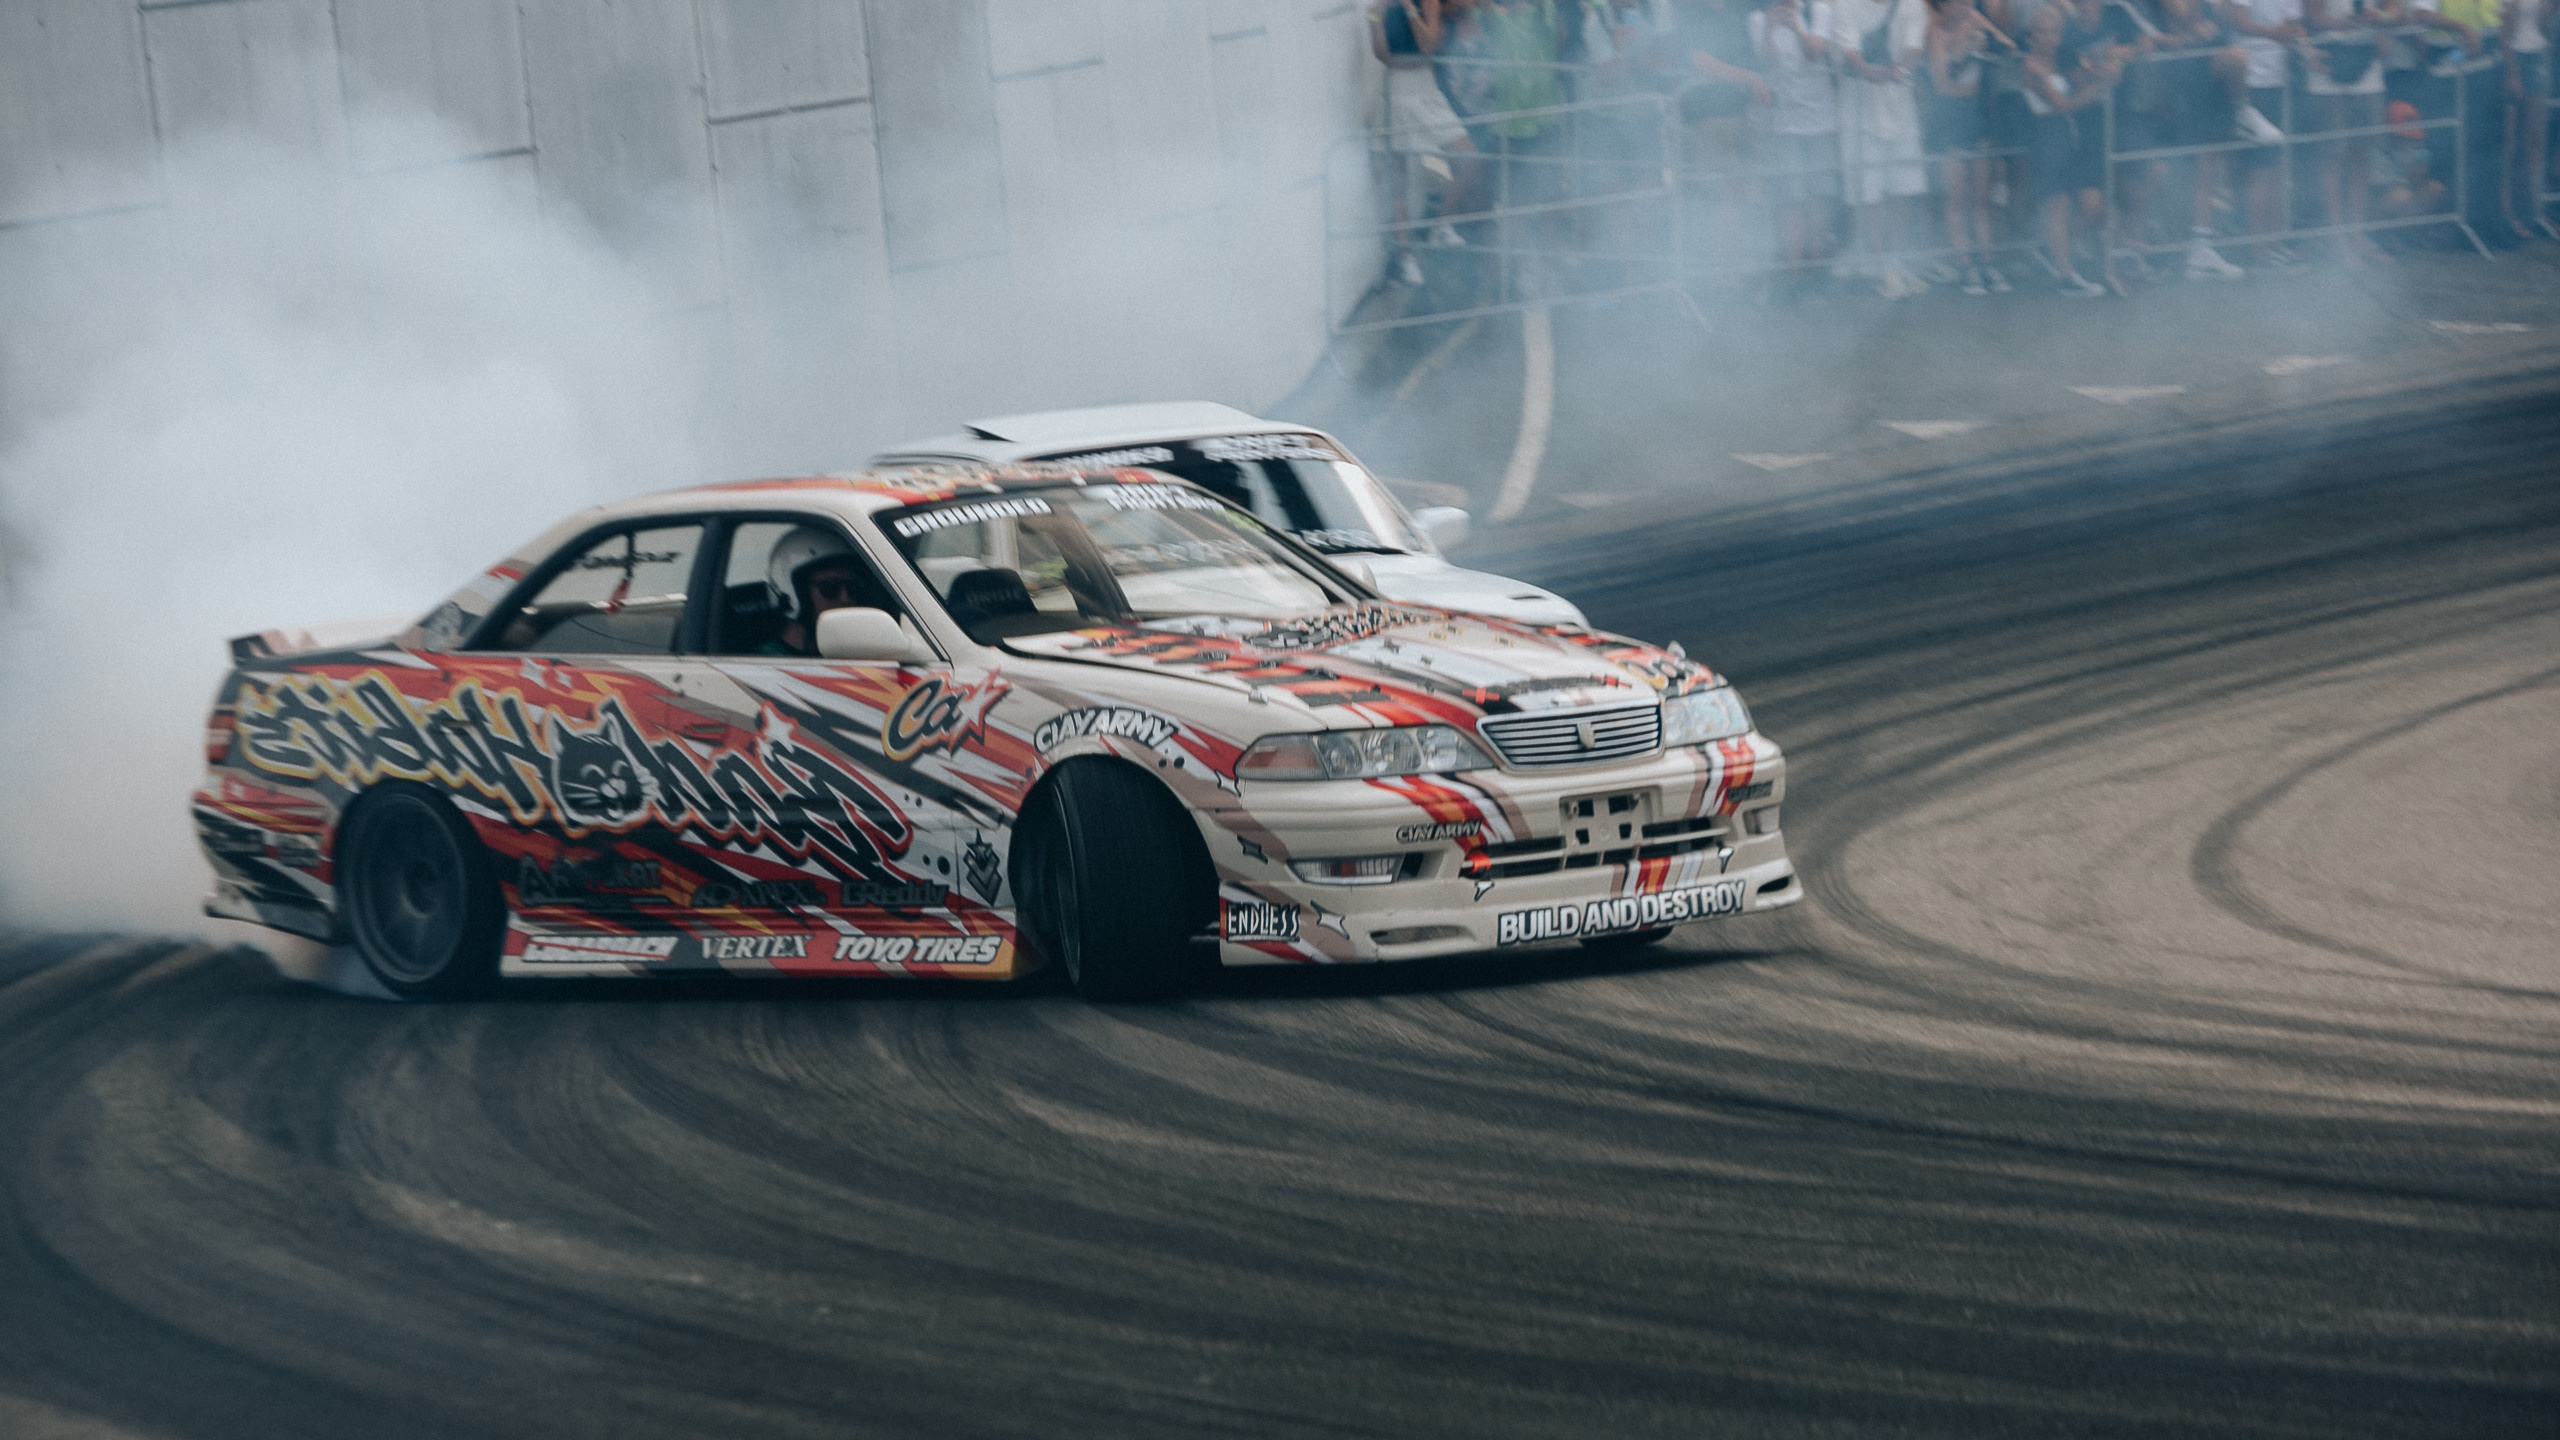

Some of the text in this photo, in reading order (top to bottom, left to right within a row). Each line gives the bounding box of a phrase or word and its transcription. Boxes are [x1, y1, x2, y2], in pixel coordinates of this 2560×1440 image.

[1227, 903, 1299, 936] ENDLESS
[1499, 880, 1745, 944] BUILD AND DESTROY
[701, 934, 813, 959] VERTEX
[834, 935, 1003, 962] TOYO TIRES
